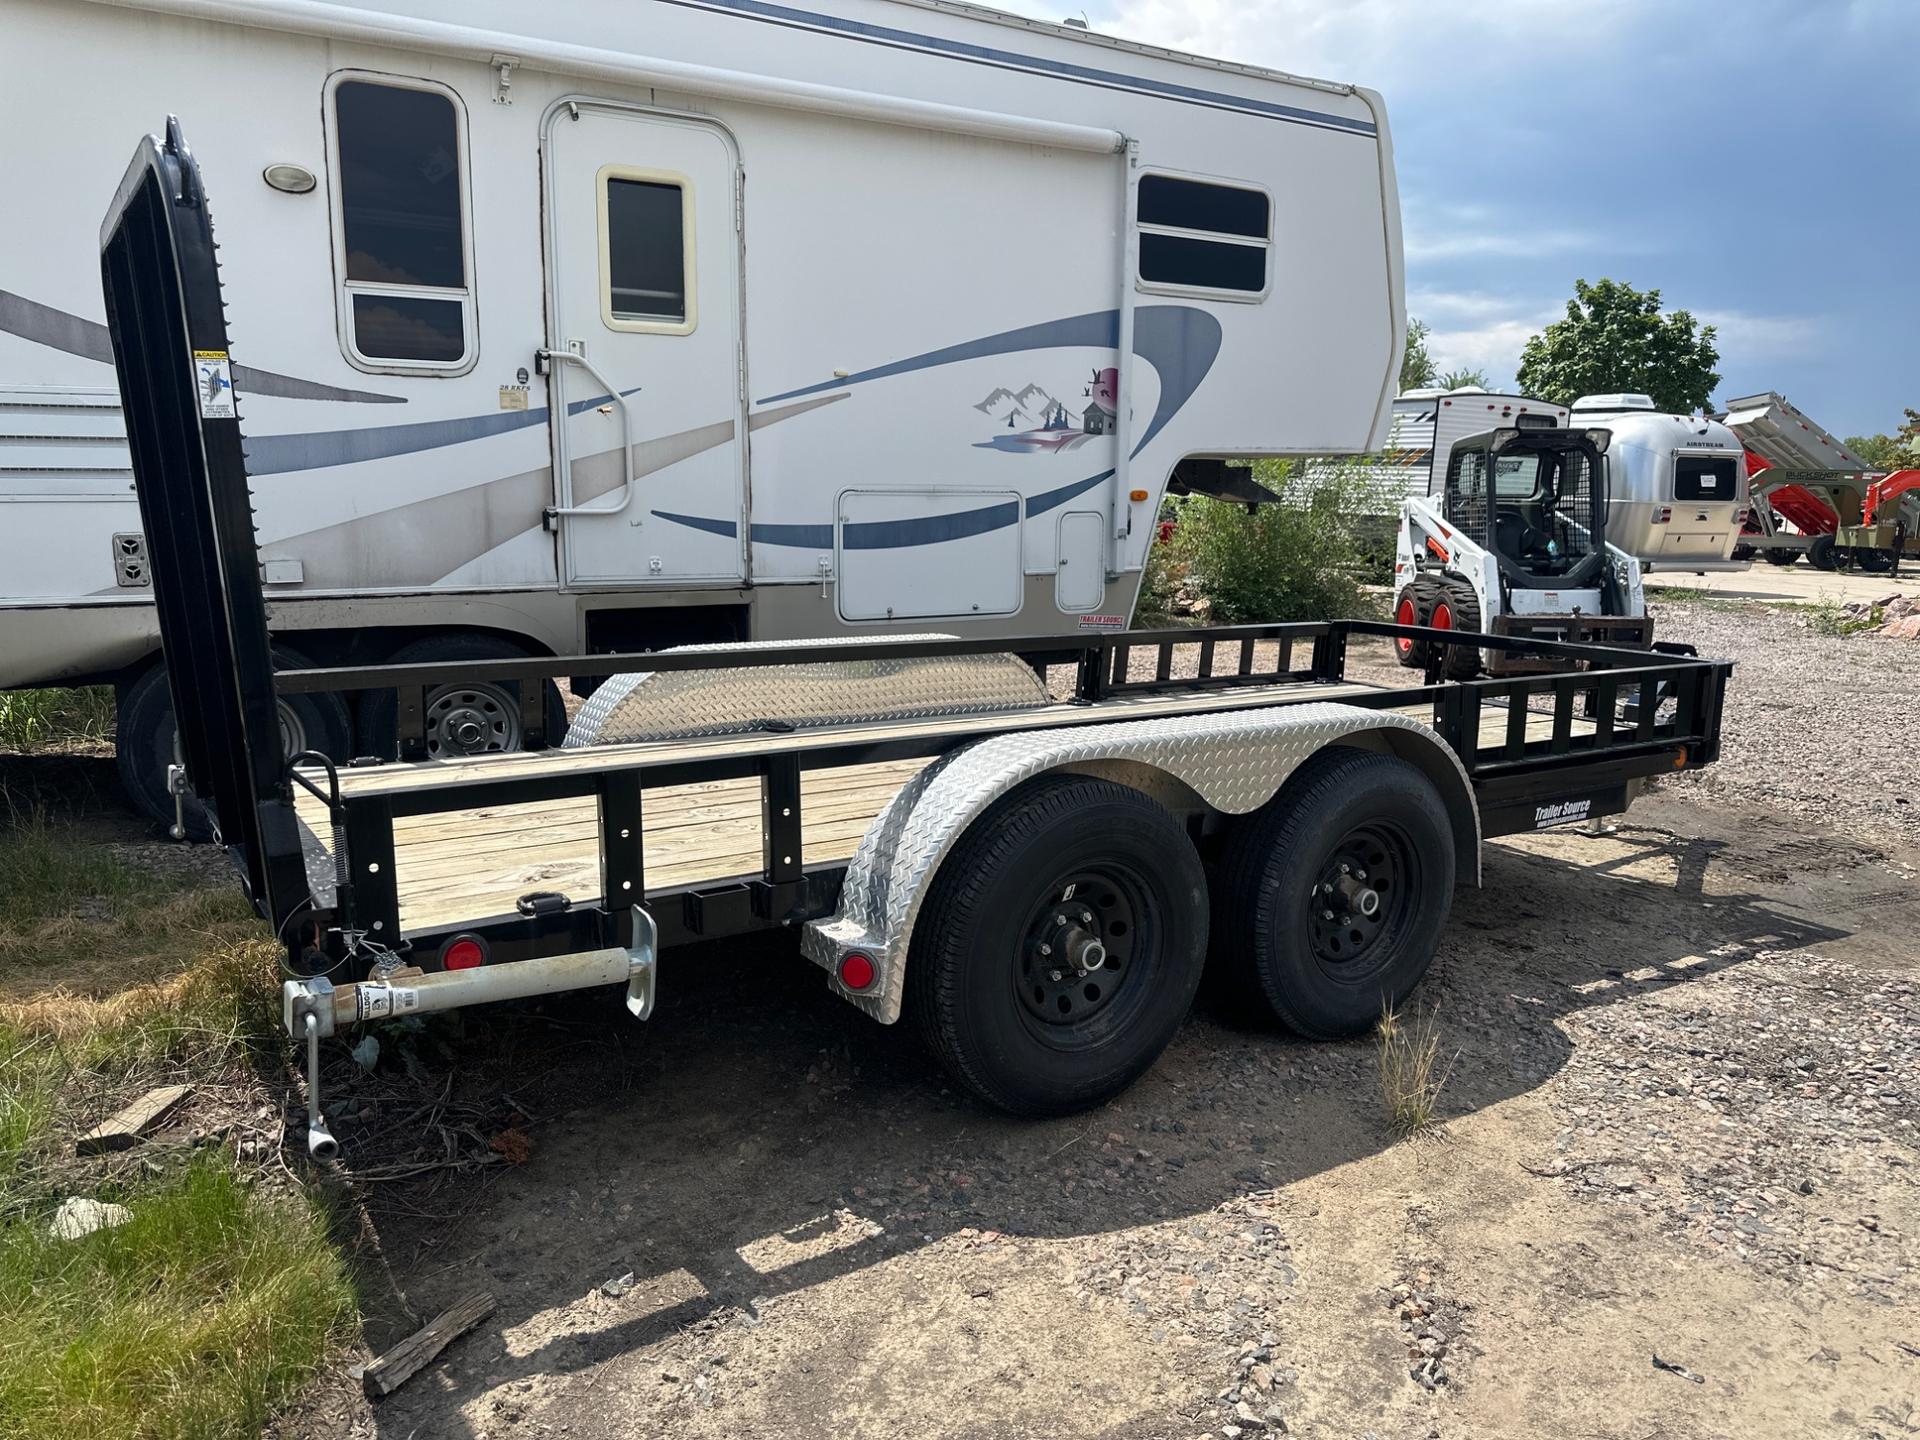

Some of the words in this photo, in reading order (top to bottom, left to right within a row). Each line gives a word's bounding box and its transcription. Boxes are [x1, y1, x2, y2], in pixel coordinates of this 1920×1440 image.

[1785, 471, 1840, 479] BUCKSHOT
[1081, 615, 1102, 623] TRAILER
[1102, 616, 1123, 624] SOURCE
[1534, 804, 1563, 821] Trailer
[1562, 799, 1591, 816] Source
[363, 991, 371, 1019] BULLDOG
